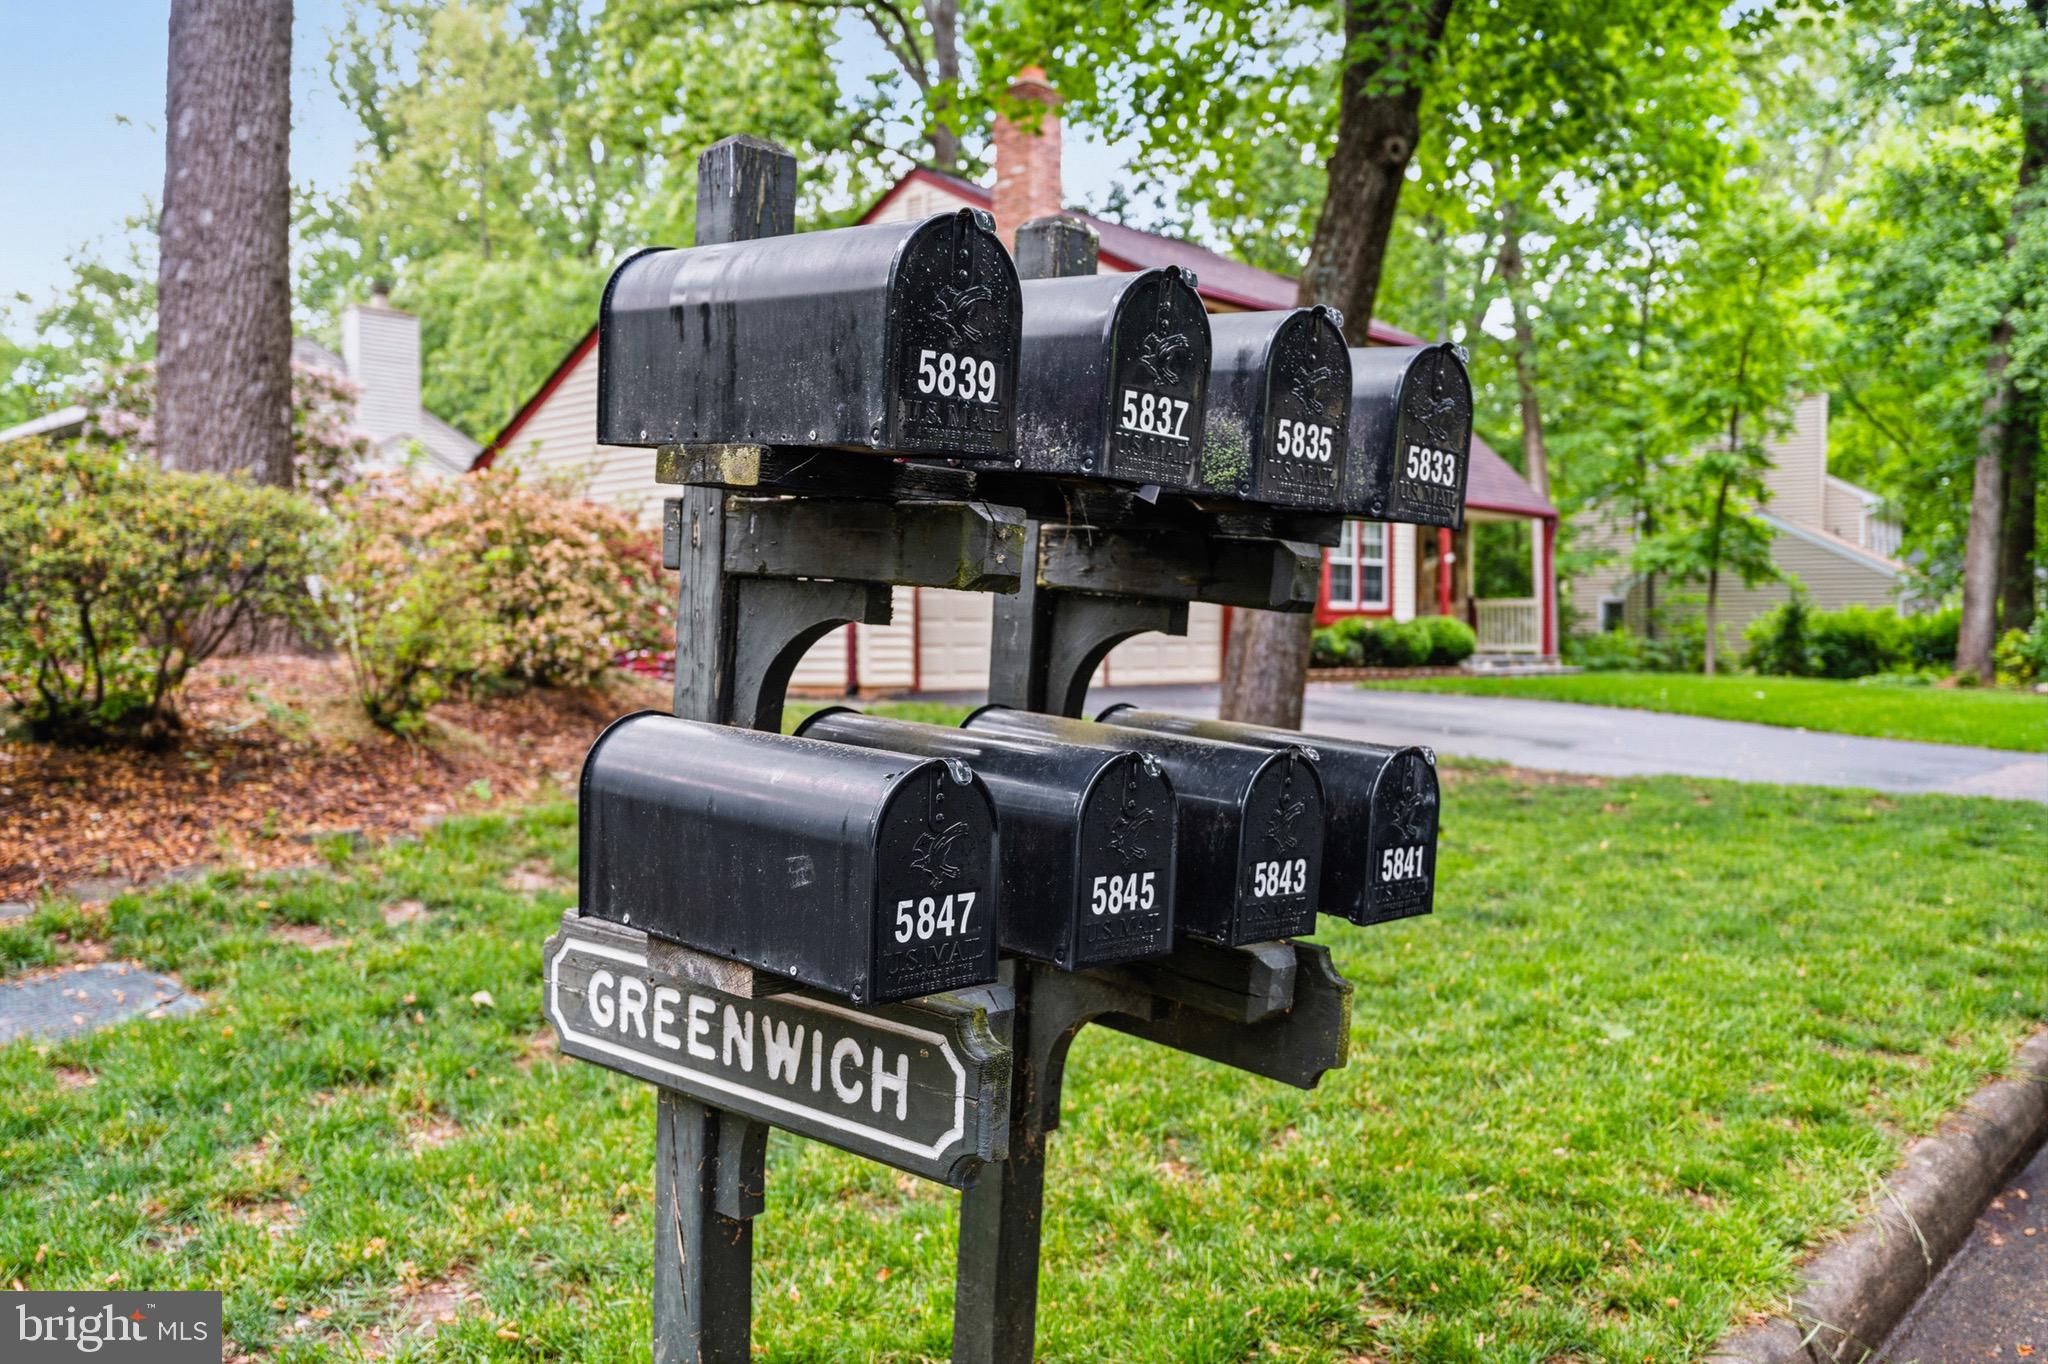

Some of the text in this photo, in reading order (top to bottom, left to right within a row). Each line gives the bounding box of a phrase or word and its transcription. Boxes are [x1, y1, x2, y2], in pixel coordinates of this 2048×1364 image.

[917, 349, 996, 404] 5839
[1121, 389, 1190, 437] 5837
[1276, 418, 1333, 463] 5835
[1406, 444, 1456, 487] 5833
[1253, 858, 1307, 898] 5843
[1381, 845, 1424, 882] 5841
[1091, 871, 1156, 915] 5845
[894, 892, 976, 943] 5847
[587, 969, 910, 1122] GREENWICH
